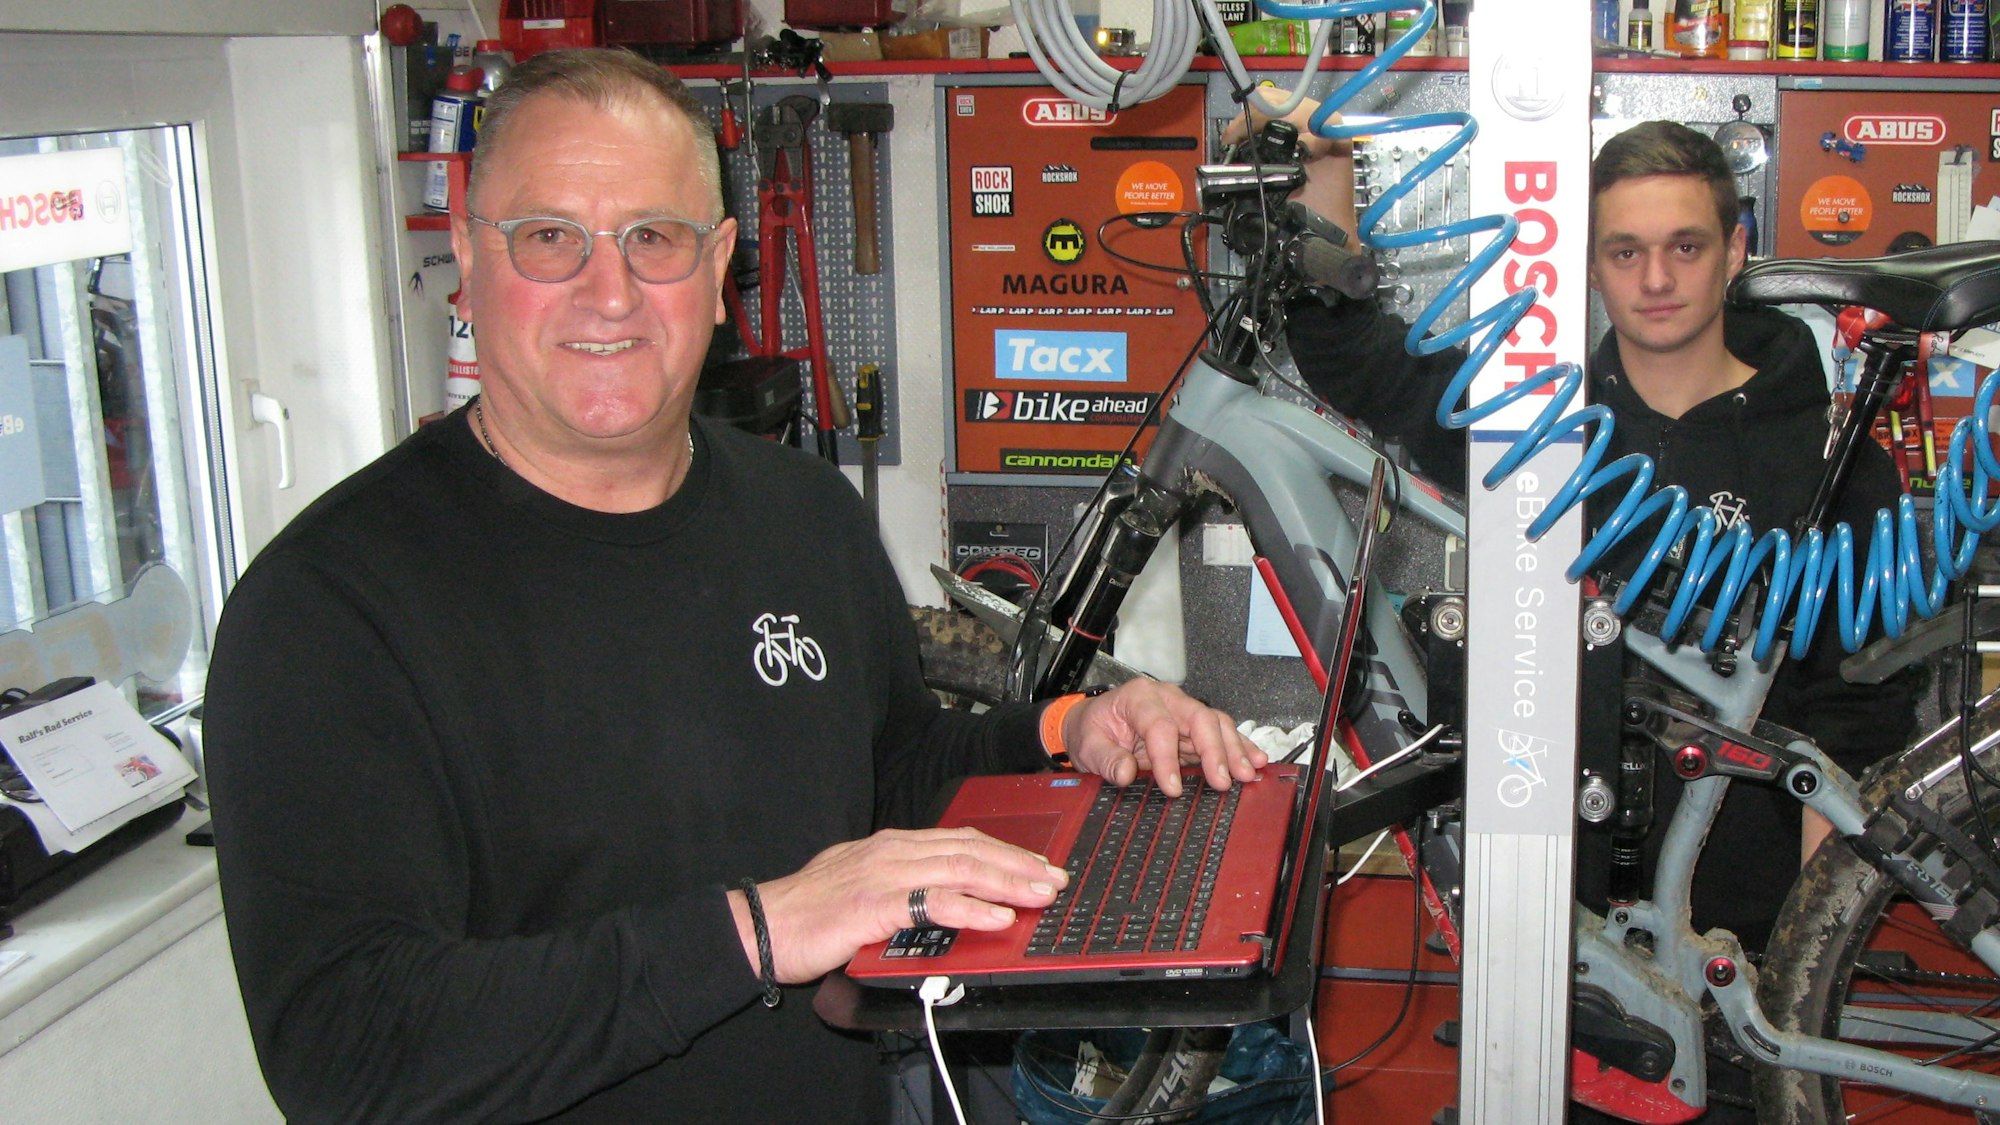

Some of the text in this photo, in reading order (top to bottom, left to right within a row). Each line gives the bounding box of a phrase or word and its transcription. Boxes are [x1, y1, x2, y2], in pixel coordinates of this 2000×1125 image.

[1217, 2, 1246, 12] BELESS
[1034, 103, 1107, 121] ABUS
[1856, 120, 1934, 140] ABUS
[975, 170, 1010, 190] ROCK
[1042, 171, 1078, 182] ROCKSHOX
[1131, 182, 1168, 190] WE MOVE
[975, 194, 1011, 214] SHOX
[1124, 191, 1176, 200] PEOPLE BETTER
[1817, 198, 1856, 206] WE MOVE
[1892, 191, 1931, 203] ROCKSHOX
[1809, 207, 1837, 215] PEOPLE
[1003, 274, 1129, 295] MAGURA
[1503, 161, 1559, 396] BOSCH
[1008, 338, 1115, 373] Tacx
[1013, 391, 1089, 422] bike
[1092, 396, 1149, 414] ahead
[1514, 586, 1544, 719] Service
[18, 710, 93, 744] Ralf's Rad Service
[1716, 740, 1773, 771] 160
[1860, 1063, 1893, 1077] BOSCH
